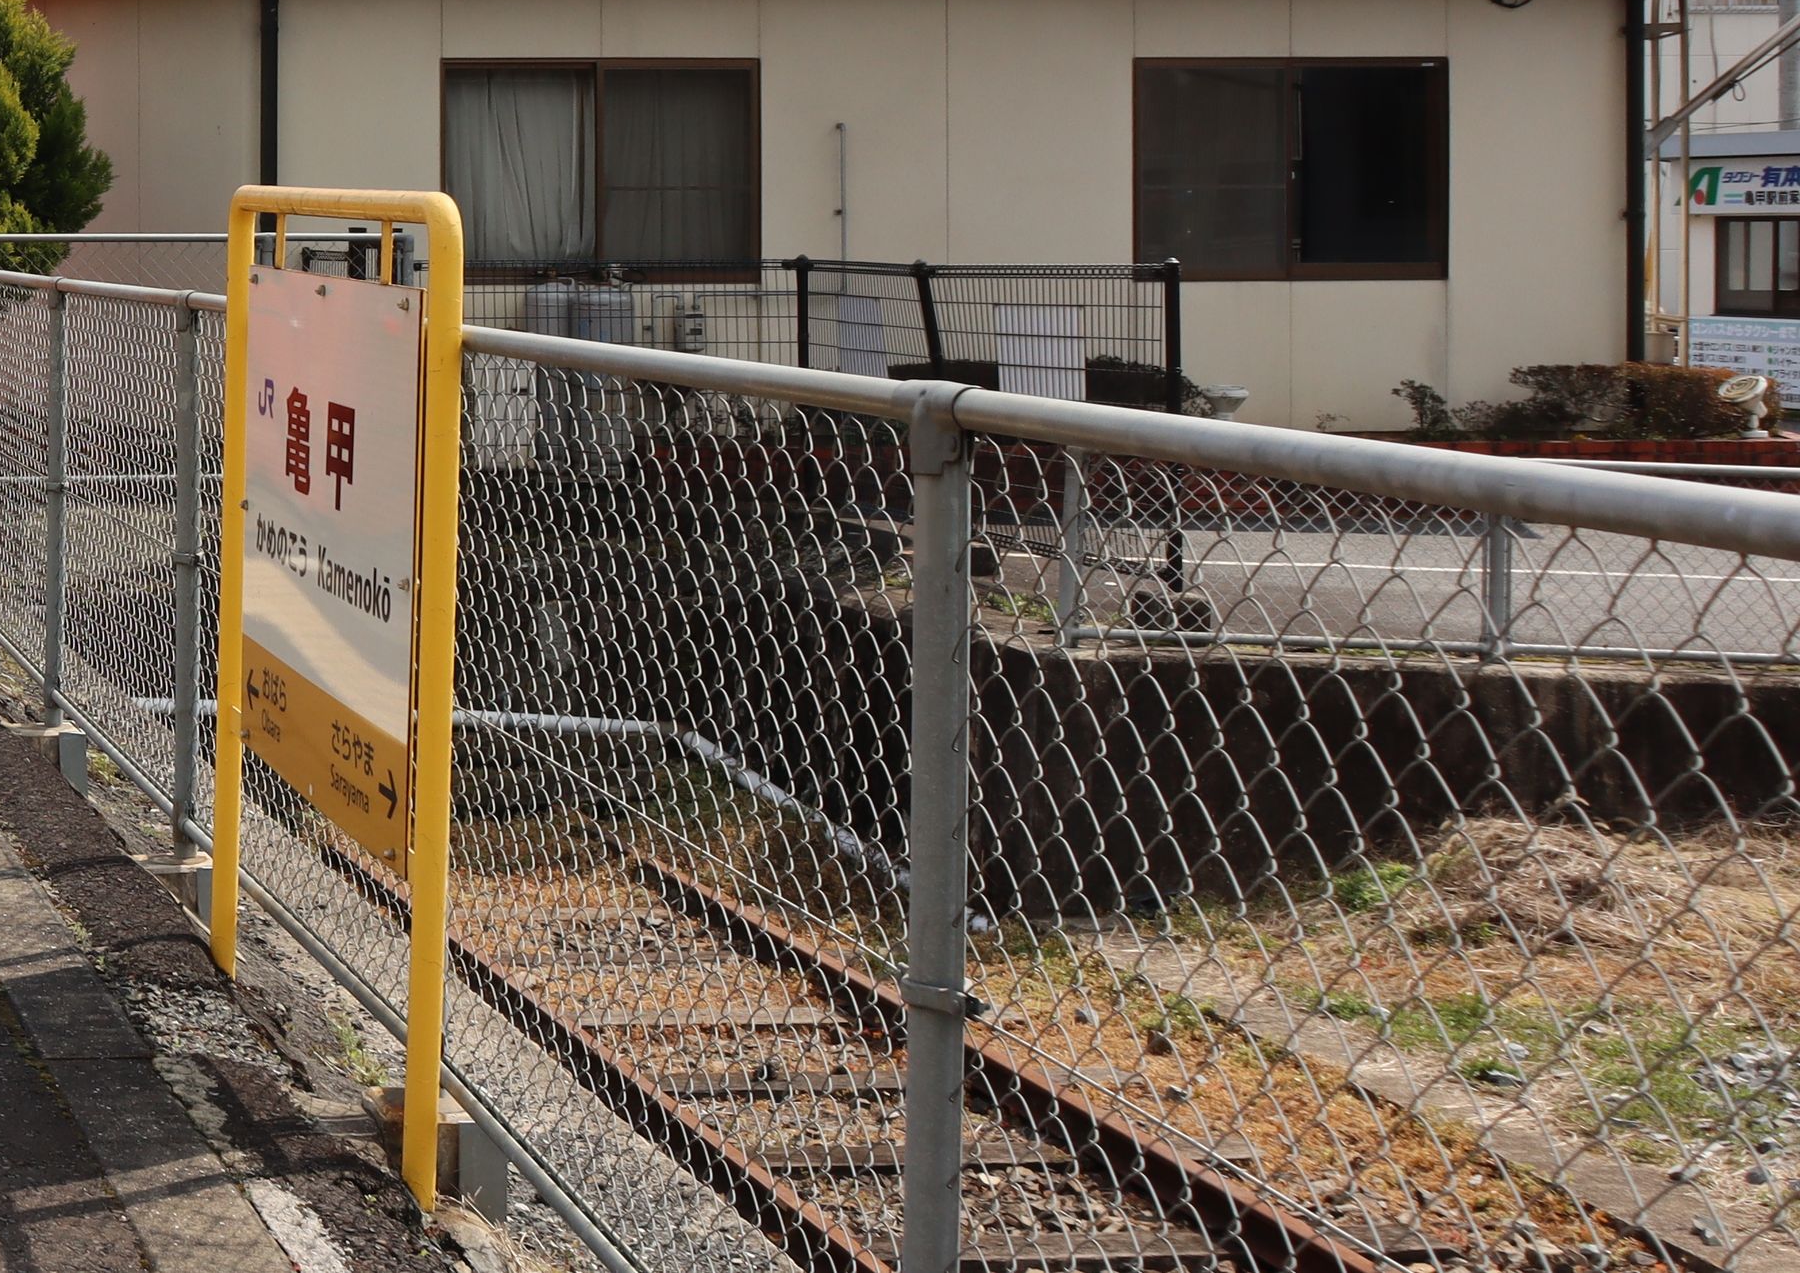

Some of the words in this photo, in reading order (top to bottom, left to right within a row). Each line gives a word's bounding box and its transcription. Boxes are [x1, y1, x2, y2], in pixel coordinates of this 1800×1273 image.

[1722, 172, 1760, 183] タクシー
[1761, 165, 1800, 187] 有本
[258, 378, 275, 419] JR
[285, 386, 356, 512] 亀甲
[256, 512, 308, 578] かめのこう
[317, 544, 392, 623] Kamenokō
[262, 667, 287, 712] おばら
[261, 709, 281, 743] Obara
[331, 719, 374, 777] さらやま
[330, 763, 370, 814] Sarayama
